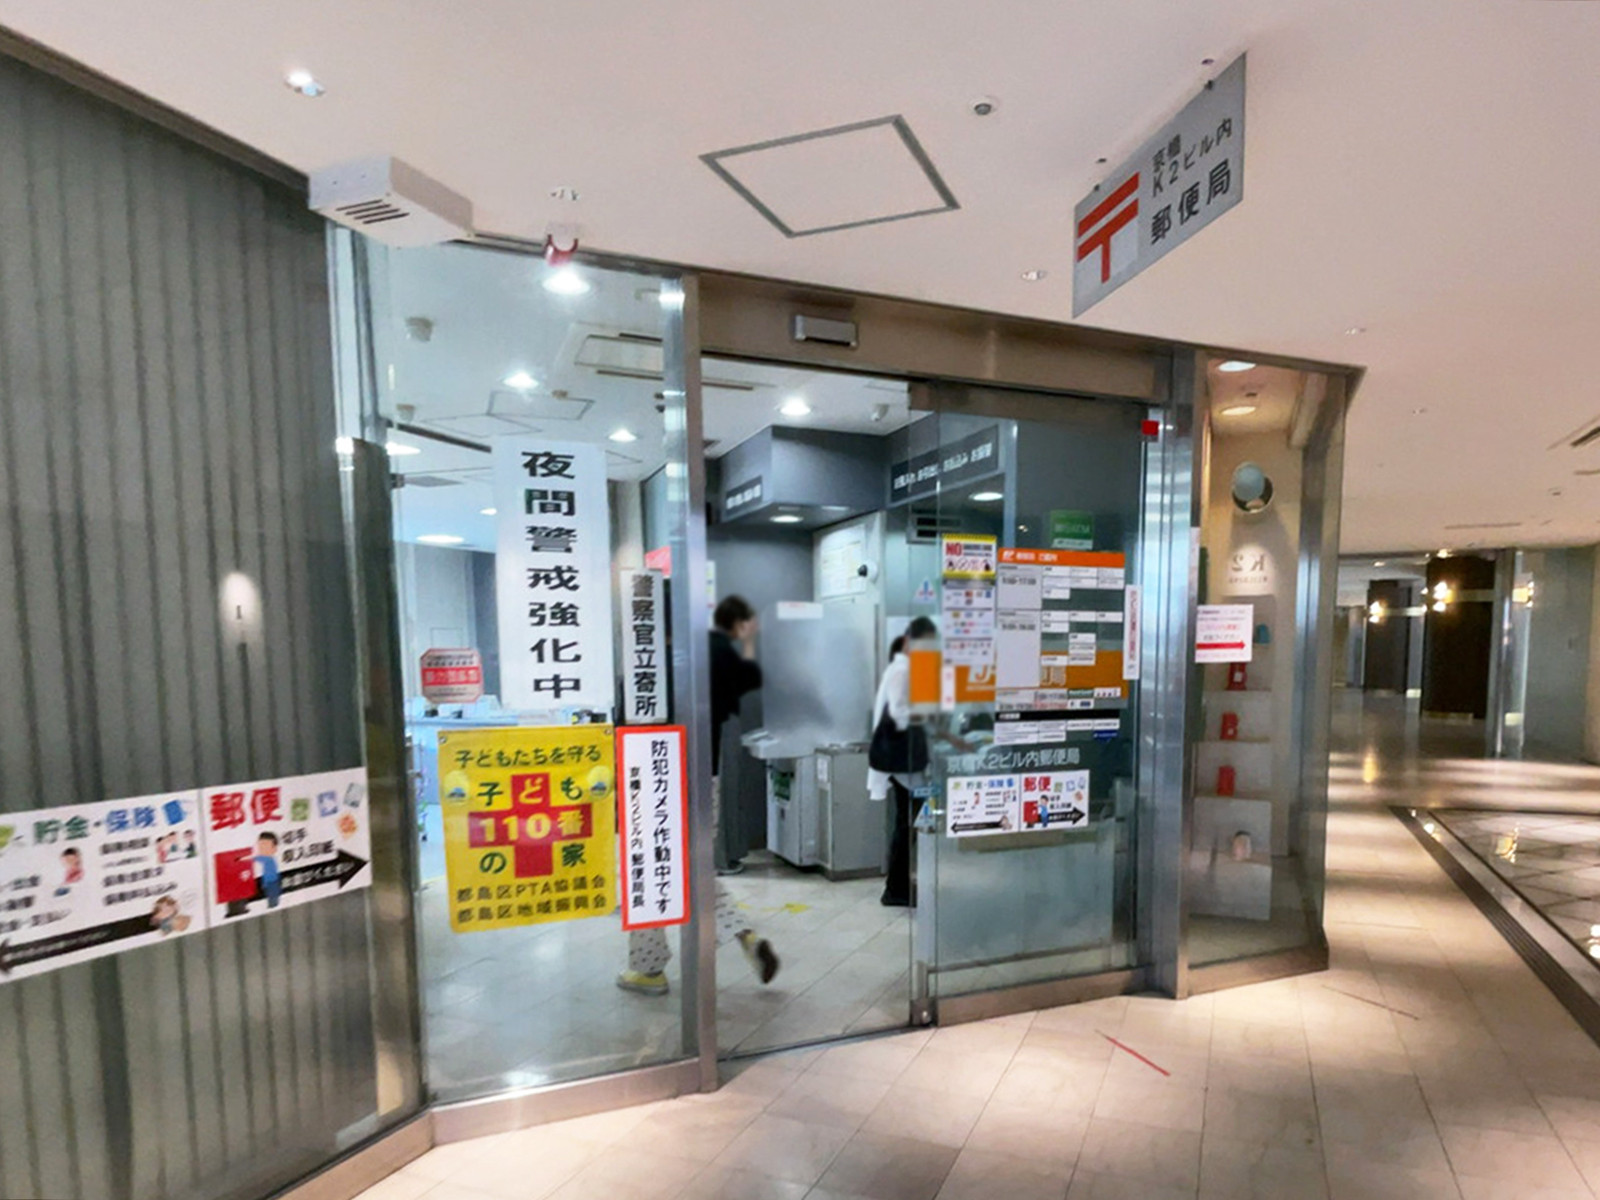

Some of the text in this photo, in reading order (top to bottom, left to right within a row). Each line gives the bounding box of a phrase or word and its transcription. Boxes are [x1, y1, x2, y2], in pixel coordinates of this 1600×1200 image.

[1151, 158, 1231, 246] 郵便局
[521, 451, 582, 699] 夜間警戒強化中
[632, 574, 657, 717] 警察官立寄所
[455, 746, 601, 769] 子どもたちを守る
[477, 777, 582, 807] 子ども
[1024, 776, 1051, 793] 郵便
[210, 786, 283, 831] 郵便
[477, 808, 584, 843] 110番
[651, 740, 671, 915] 防犯カメラ作動中です
[479, 844, 586, 874] の 家
